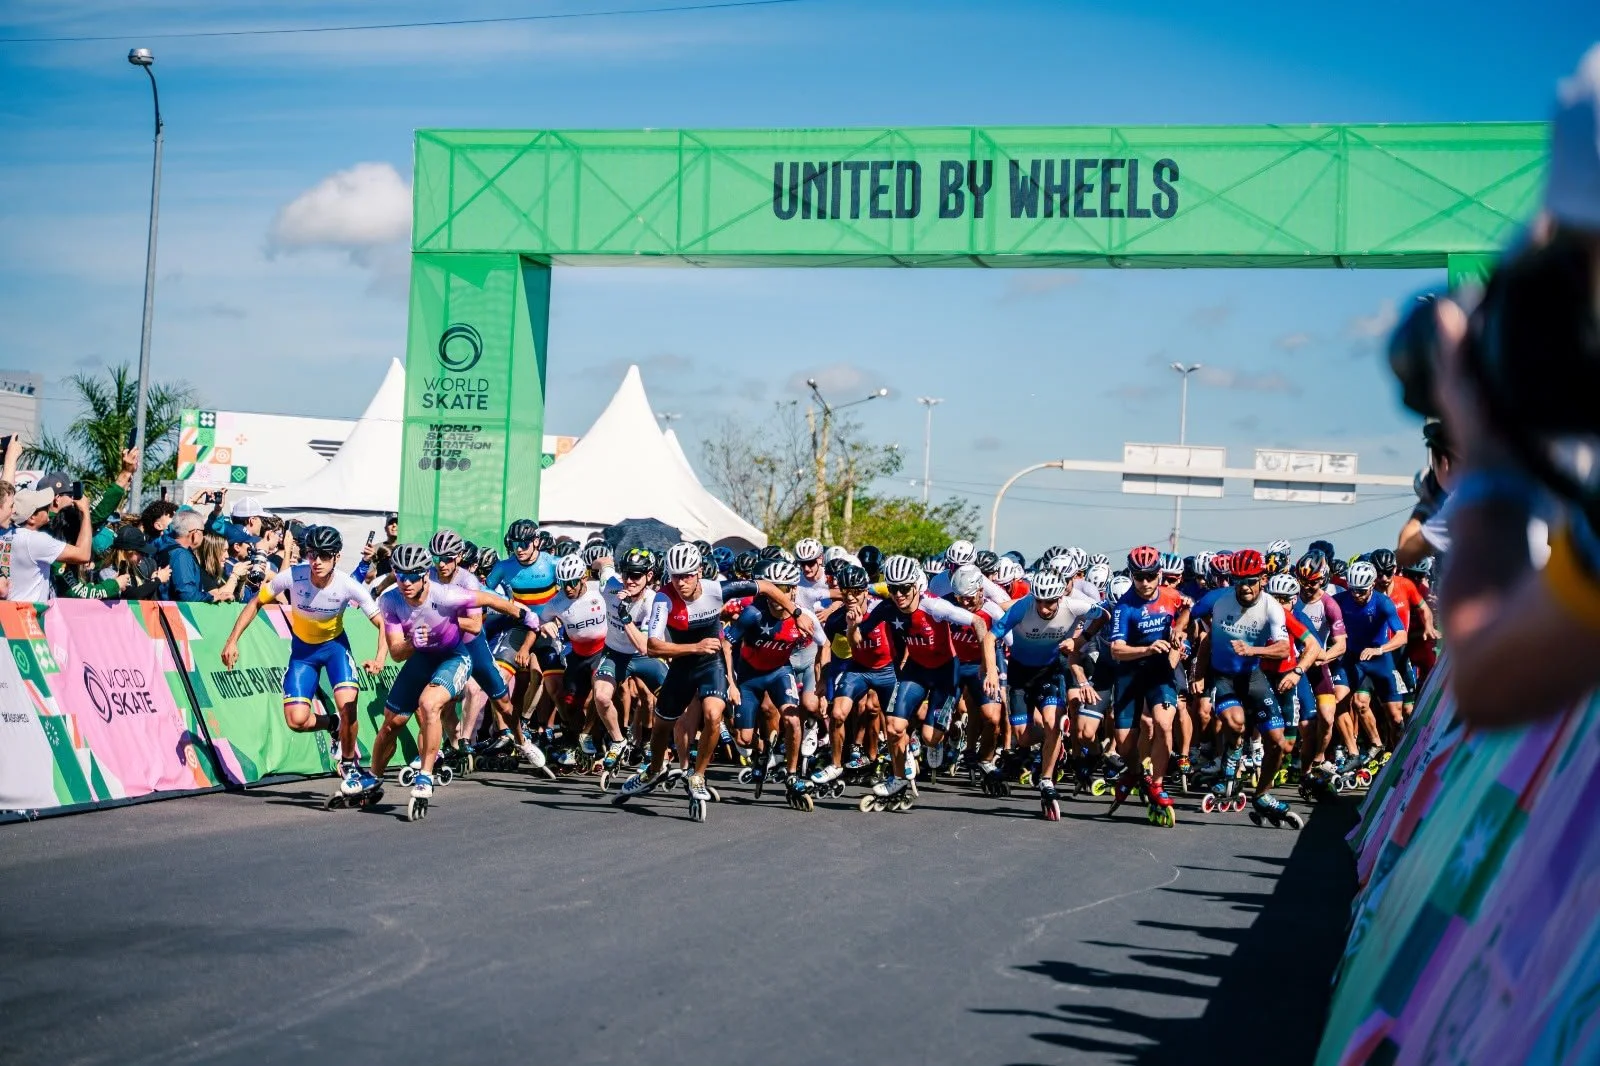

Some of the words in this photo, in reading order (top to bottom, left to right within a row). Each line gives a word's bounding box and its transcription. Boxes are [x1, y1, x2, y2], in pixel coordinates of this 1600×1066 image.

[772, 160, 921, 220] UNITED
[939, 159, 993, 219] BY
[1008, 158, 1180, 219] WHEELS
[423, 377, 489, 392] WORLD
[422, 392, 489, 410] SKATE
[429, 423, 482, 433] WORLD
[423, 440, 492, 450] MARATHON
[426, 432, 475, 442] SKATE
[423, 448, 462, 457] TOUR
[101, 669, 145, 688] WORLD
[210, 669, 254, 699] UNITED
[245, 667, 269, 694] BY
[111, 692, 157, 716] SKATE
